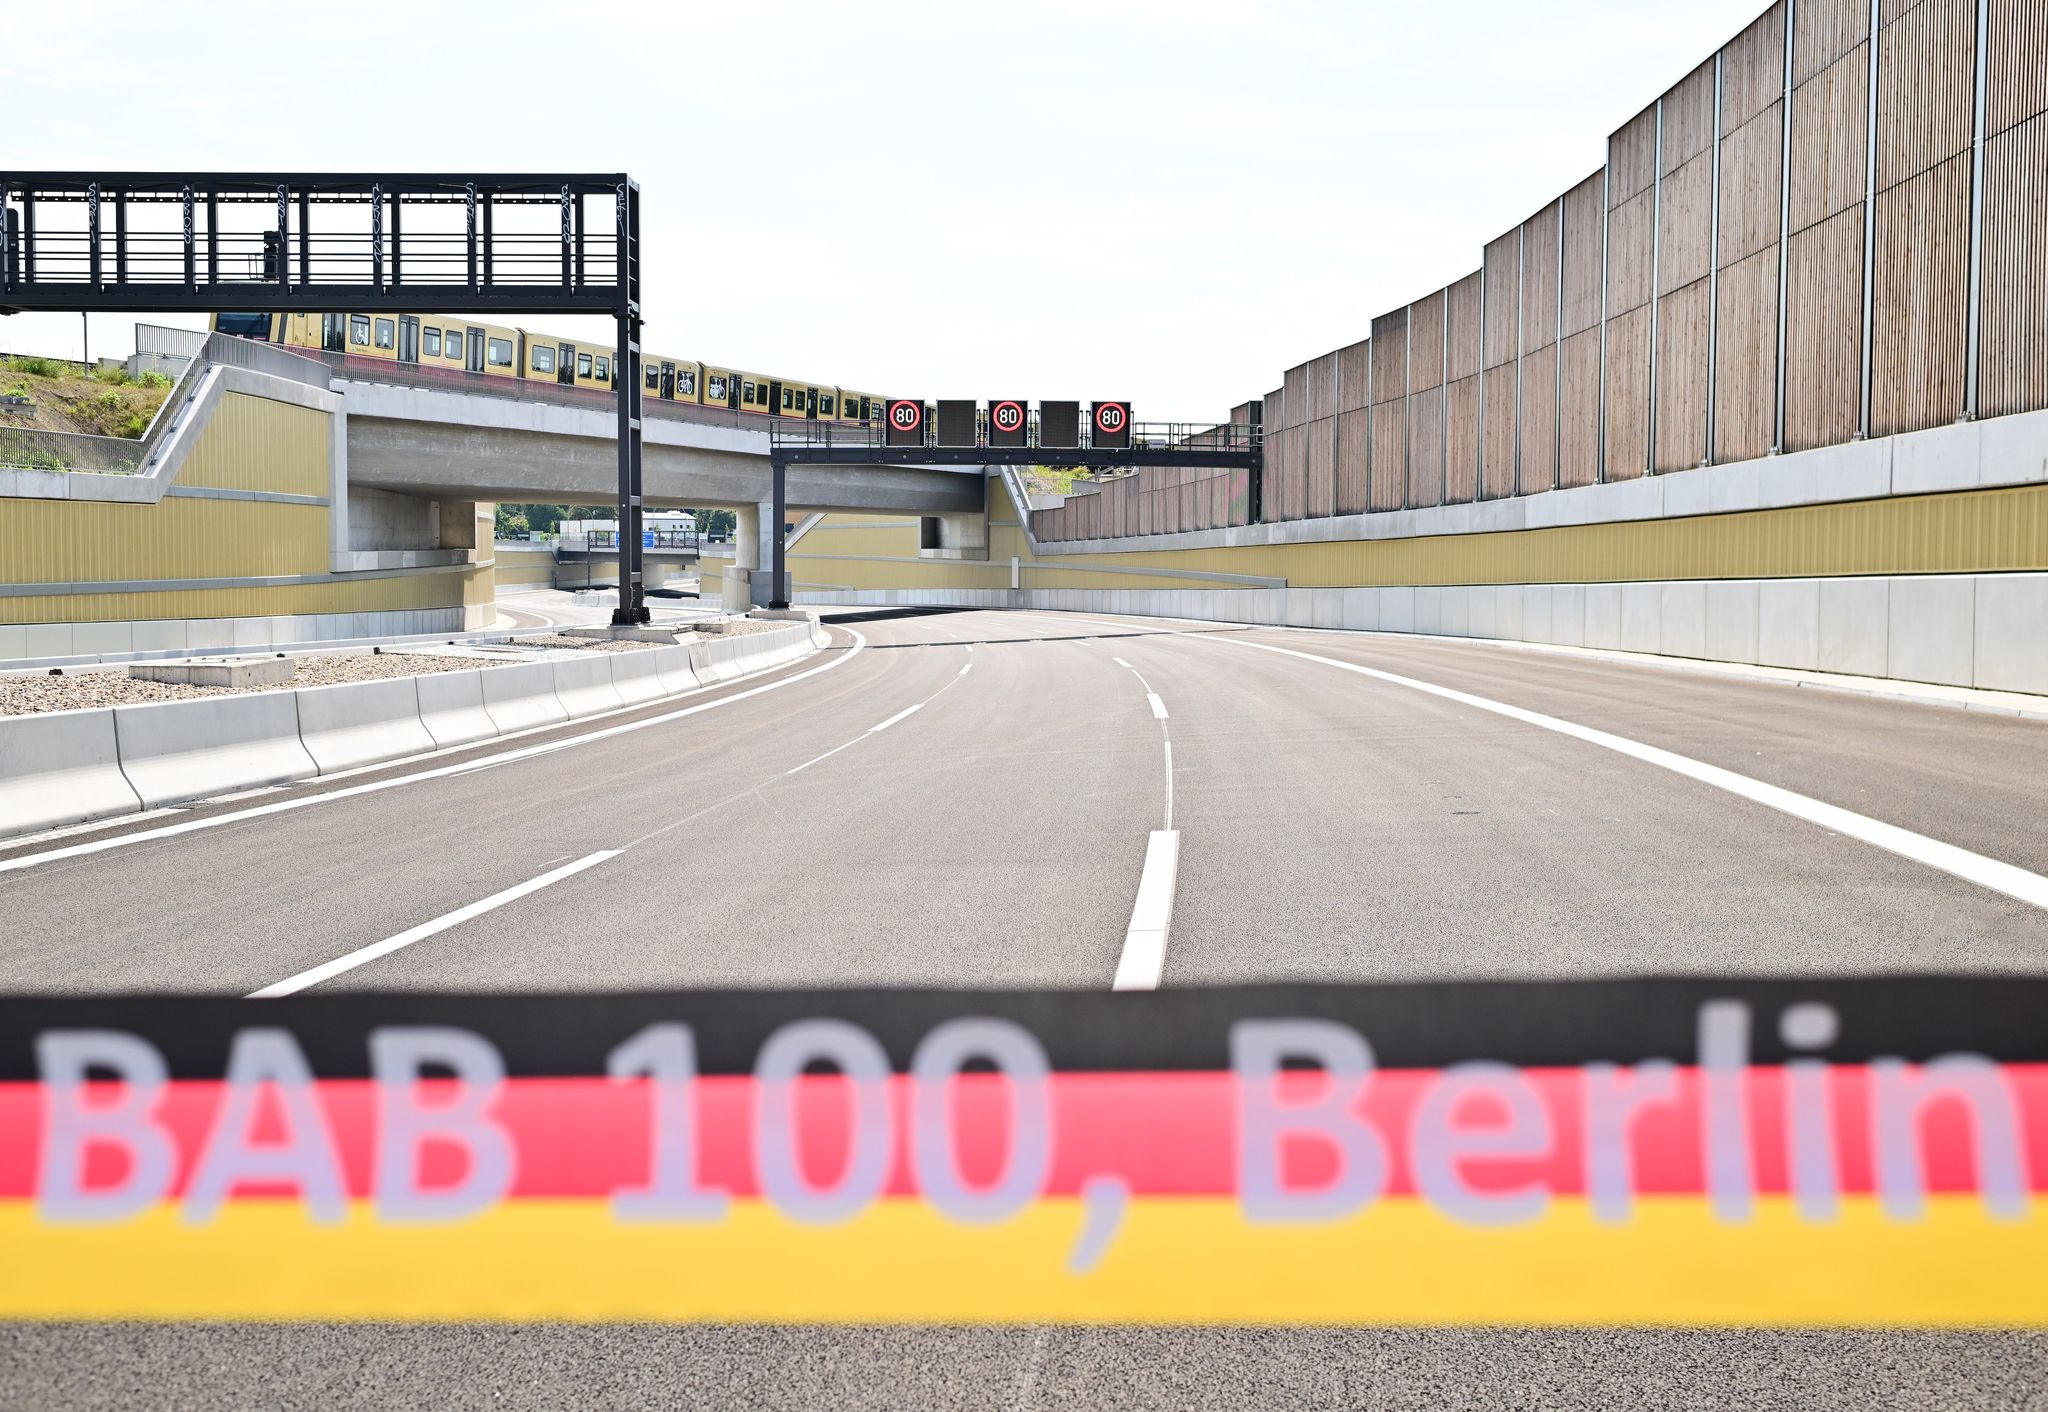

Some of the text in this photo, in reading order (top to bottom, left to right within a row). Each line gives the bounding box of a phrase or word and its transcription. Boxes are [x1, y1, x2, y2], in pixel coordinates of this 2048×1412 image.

[896, 408, 914, 423] 80
[999, 408, 1017, 424] 80
[1102, 410, 1120, 425] 80
[35, 1001, 2032, 1275] BAB 100, Berlin
